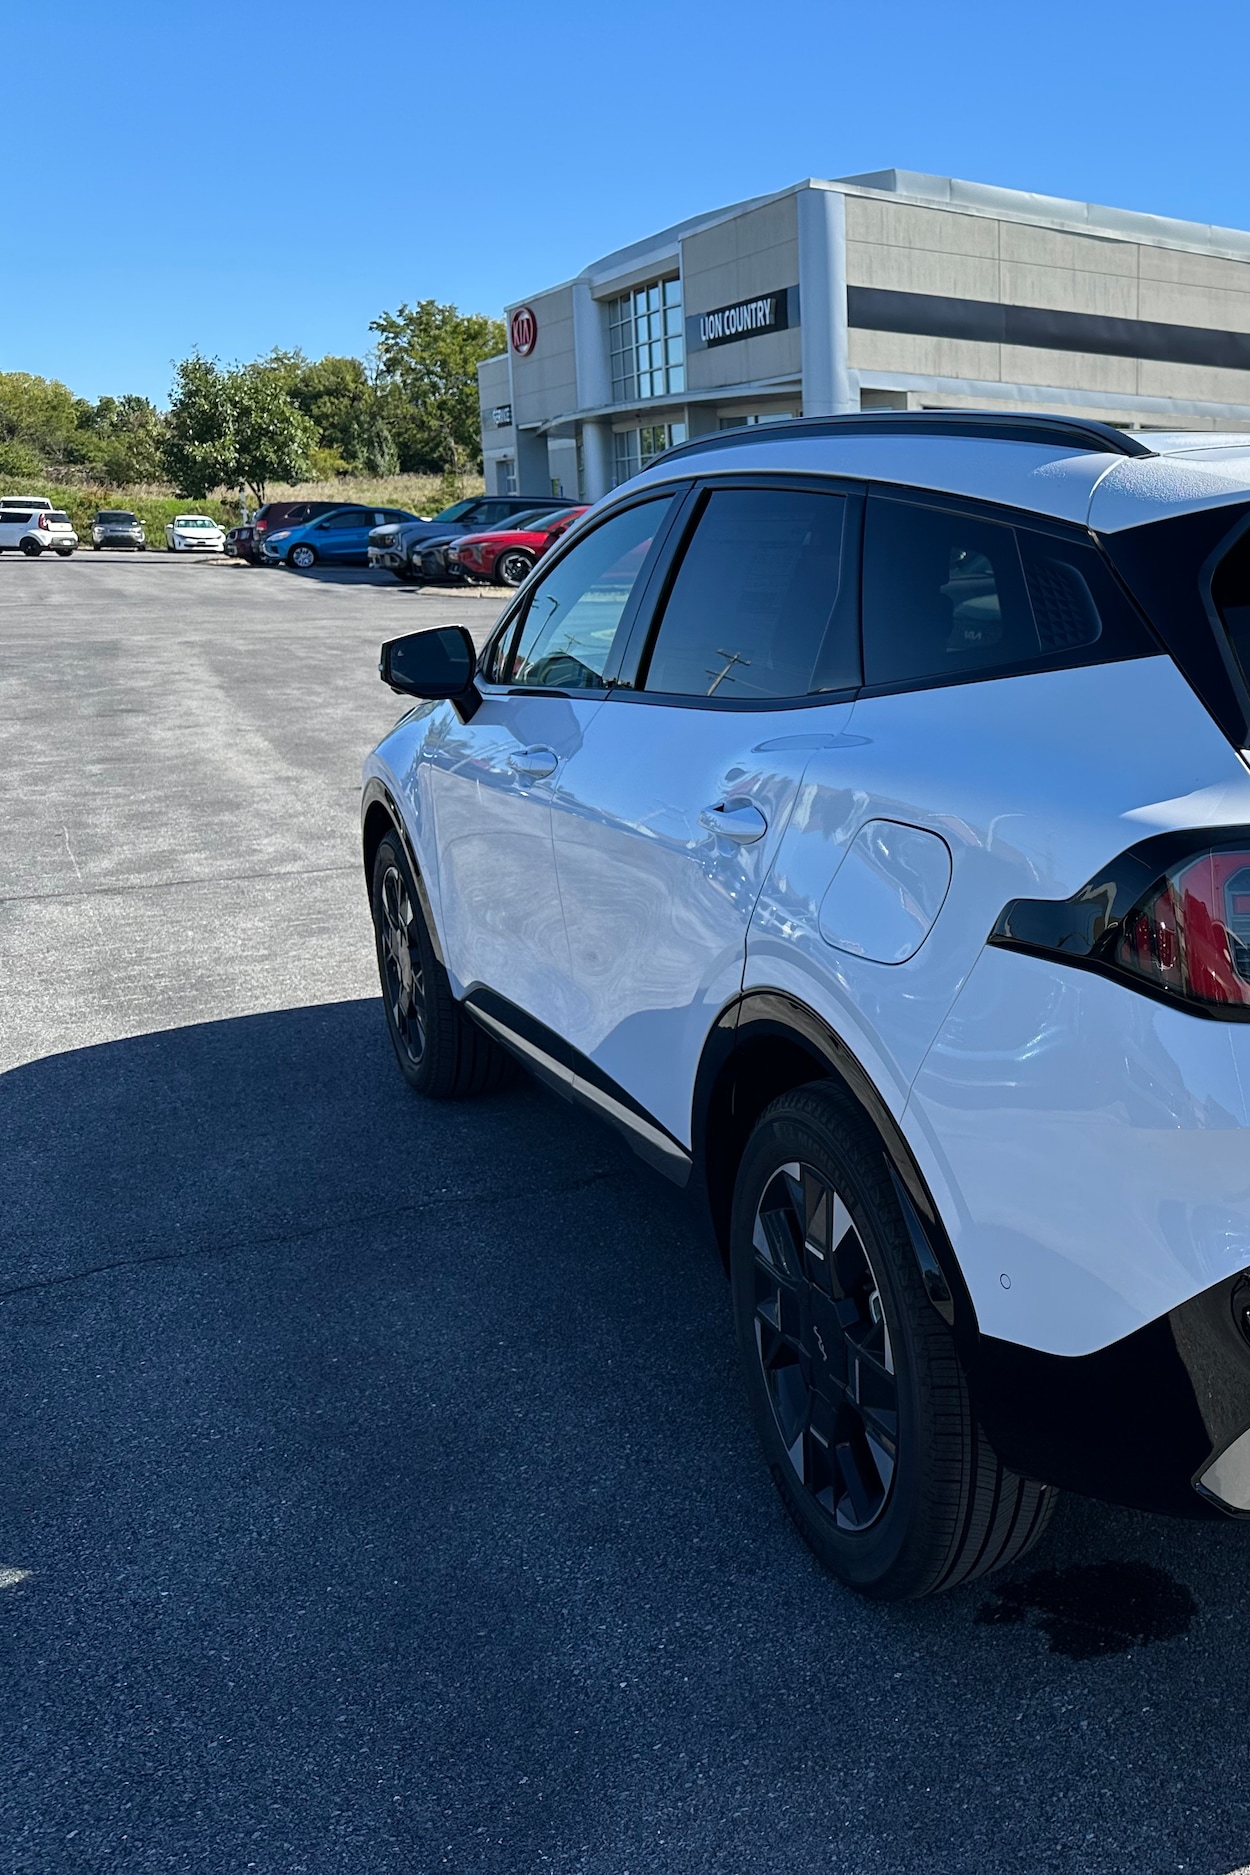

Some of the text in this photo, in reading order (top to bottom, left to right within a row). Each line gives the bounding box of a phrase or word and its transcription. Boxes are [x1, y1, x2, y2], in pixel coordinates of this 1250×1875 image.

[512, 319, 530, 347] KIA
[700, 298, 771, 341] LION COUNTRY
[798, 1130, 855, 1205] MICHELIN
